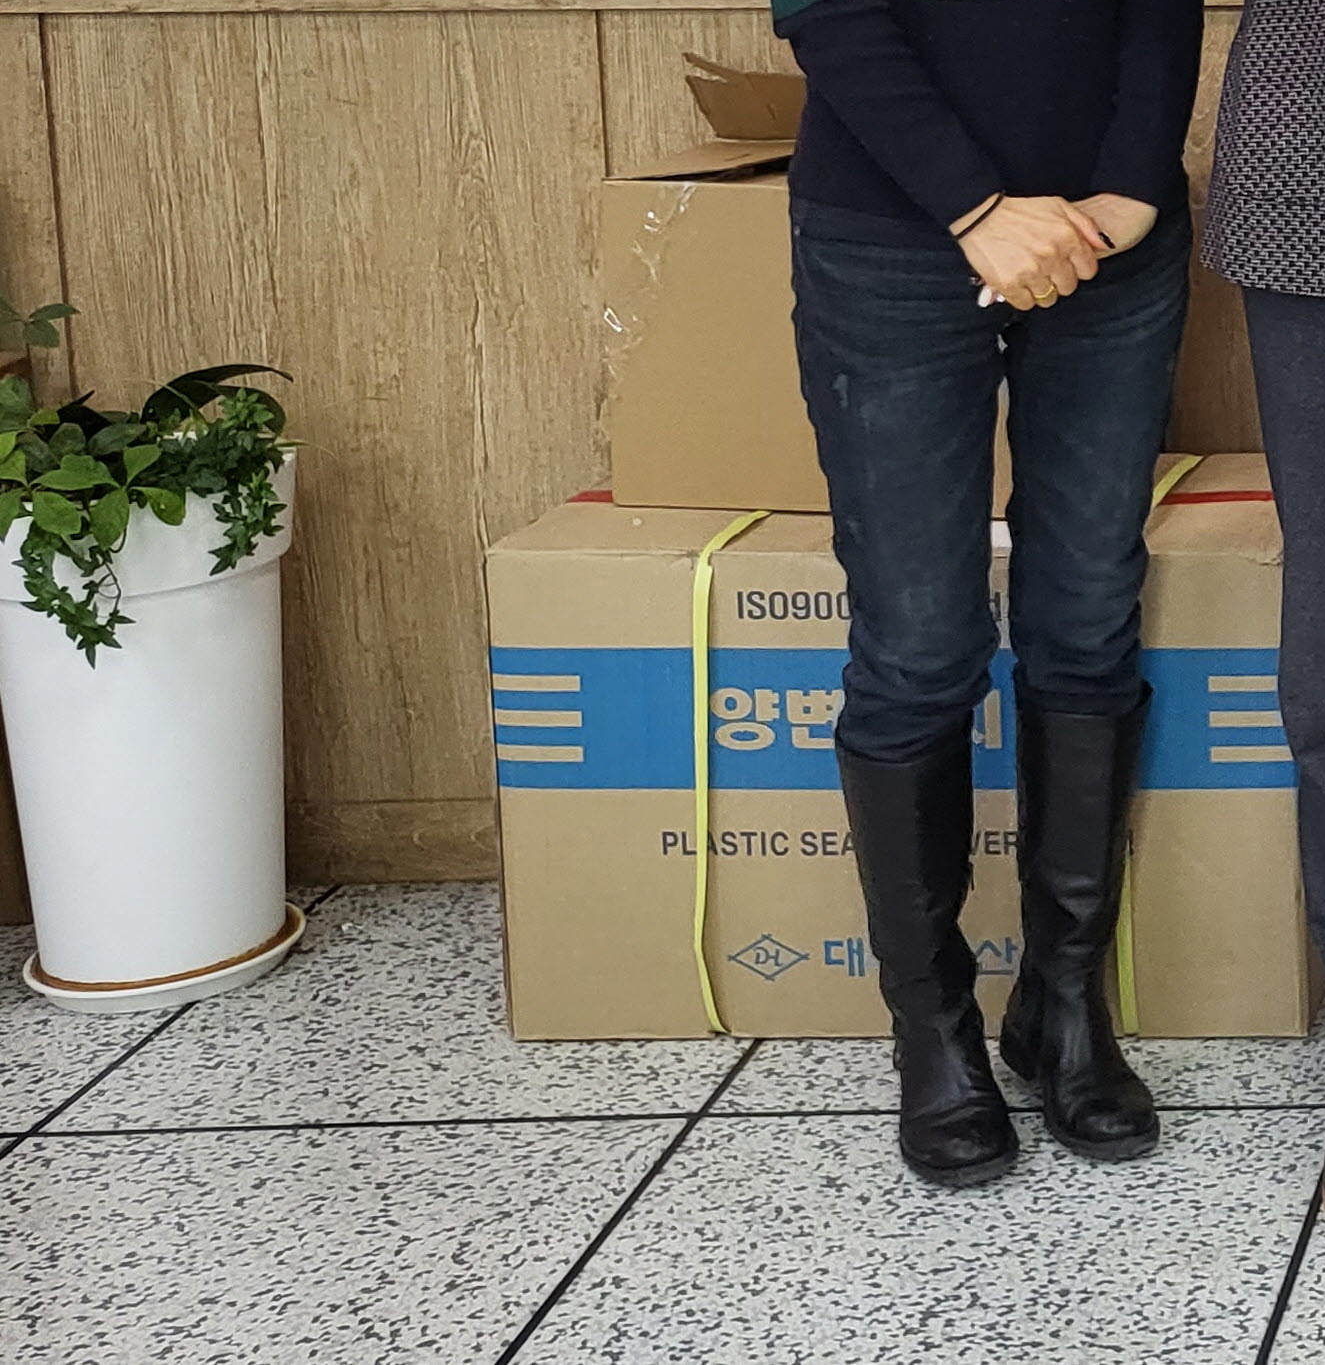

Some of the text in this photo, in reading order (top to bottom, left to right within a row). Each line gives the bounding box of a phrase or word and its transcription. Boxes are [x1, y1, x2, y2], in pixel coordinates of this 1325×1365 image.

[737, 590, 850, 621] ISO900
[662, 831, 789, 856] PLASTIC
[800, 831, 857, 856] SEA
